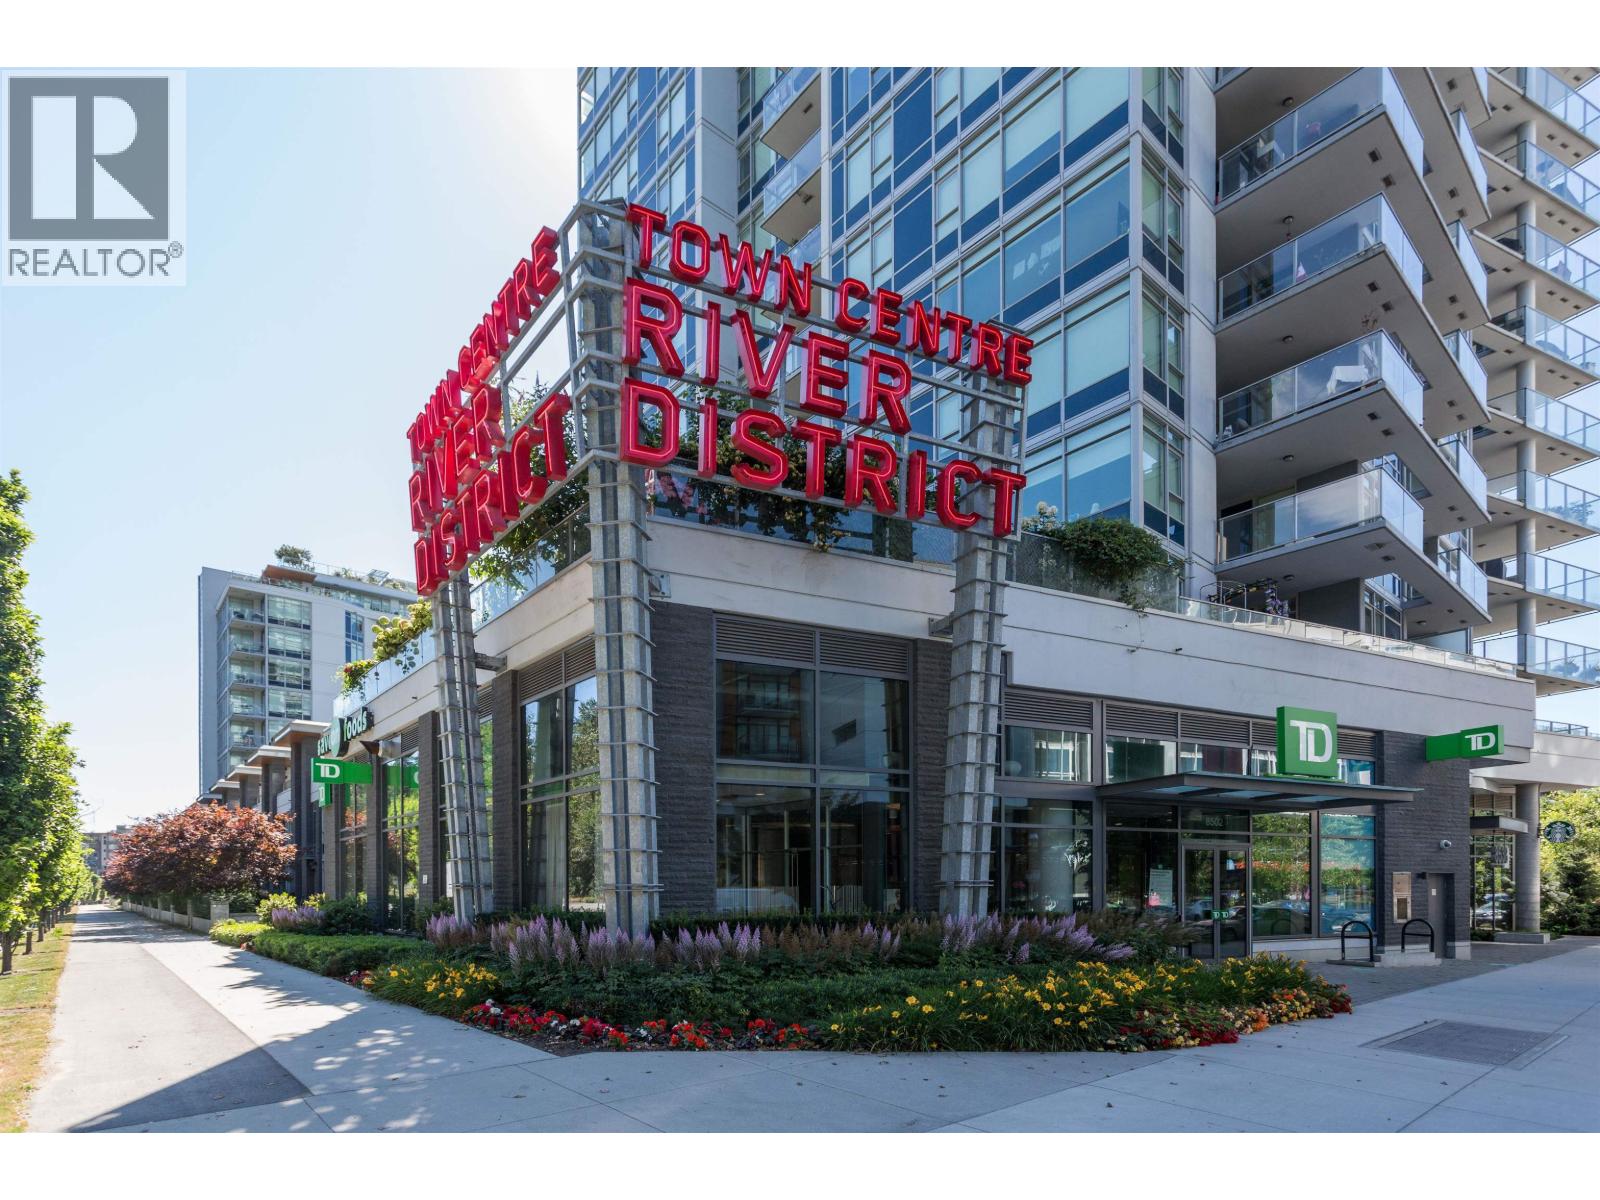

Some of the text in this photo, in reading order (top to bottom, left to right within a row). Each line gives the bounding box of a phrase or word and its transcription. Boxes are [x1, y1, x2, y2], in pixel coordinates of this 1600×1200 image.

[406, 225, 561, 464] TOWN CENTRE
[622, 276, 913, 436] RIVER
[626, 203, 1034, 386] TOWN CENTRE
[408, 383, 506, 532] RIVER
[413, 392, 571, 597] DISTRICT
[620, 377, 1027, 537] DISTRICT
[315, 762, 341, 779] TD
[343, 707, 368, 742] foods
[1289, 719, 1333, 763] TD
[1464, 731, 1496, 751] TD
